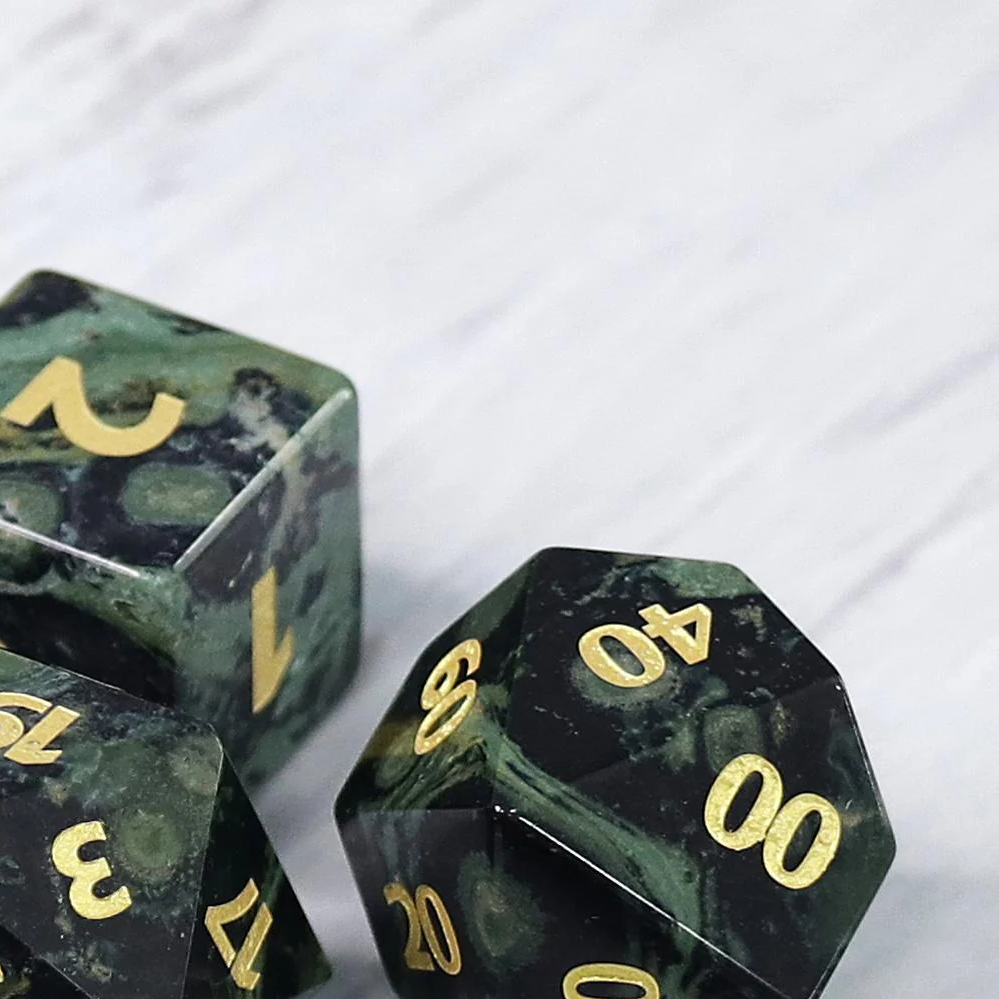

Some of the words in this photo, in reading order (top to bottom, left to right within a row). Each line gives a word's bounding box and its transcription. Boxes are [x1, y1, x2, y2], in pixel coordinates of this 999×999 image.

[0, 355, 188, 458] 2
[577, 602, 713, 690] 40
[51, 820, 133, 920] 3
[704, 752, 844, 891] 00
[204, 877, 274, 992] 17
[384, 881, 462, 977] 20
